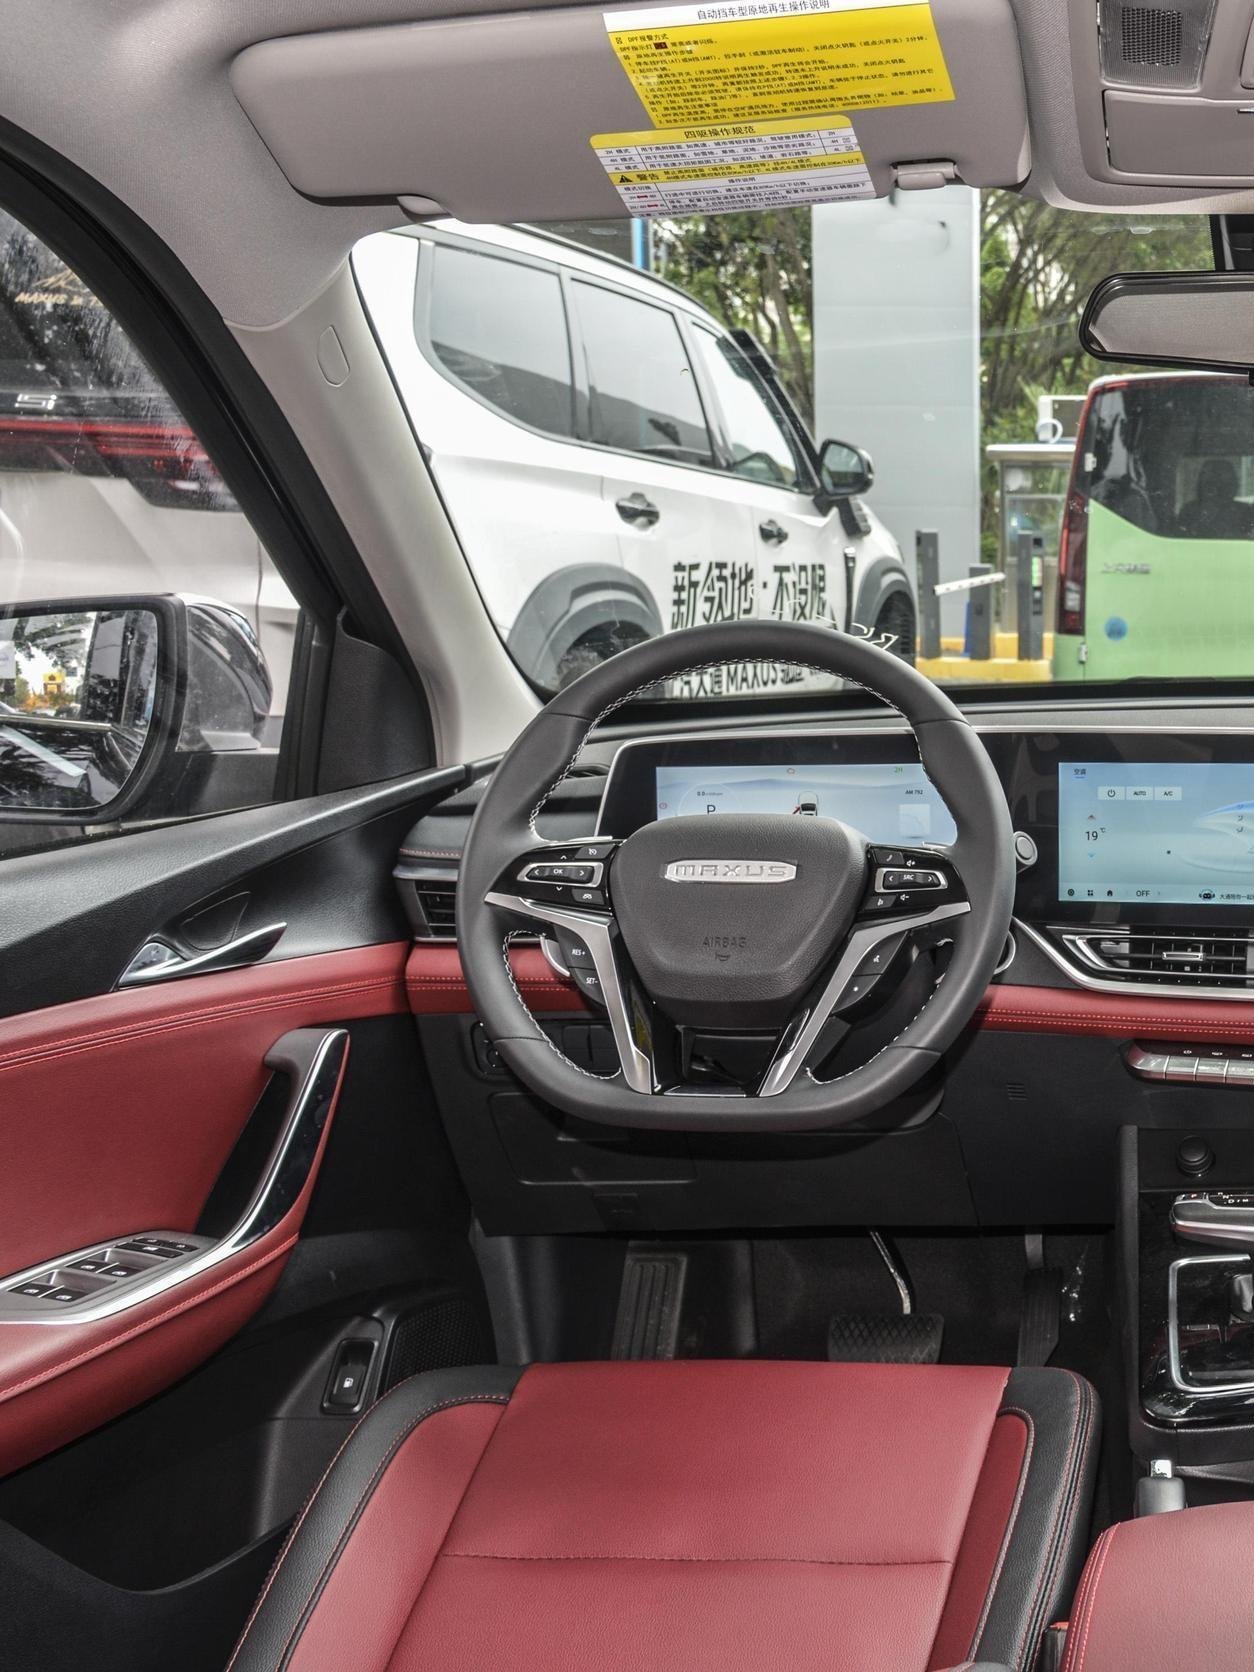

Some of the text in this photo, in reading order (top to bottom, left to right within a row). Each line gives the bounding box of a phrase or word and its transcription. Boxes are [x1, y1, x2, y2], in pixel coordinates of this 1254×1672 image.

[684, 126, 756, 139] 四驱操作规范
[706, 804, 716, 815] P
[1085, 831, 1099, 841] 19
[675, 864, 787, 877] MAXUS
[702, 936, 748, 948] AIRBAG
